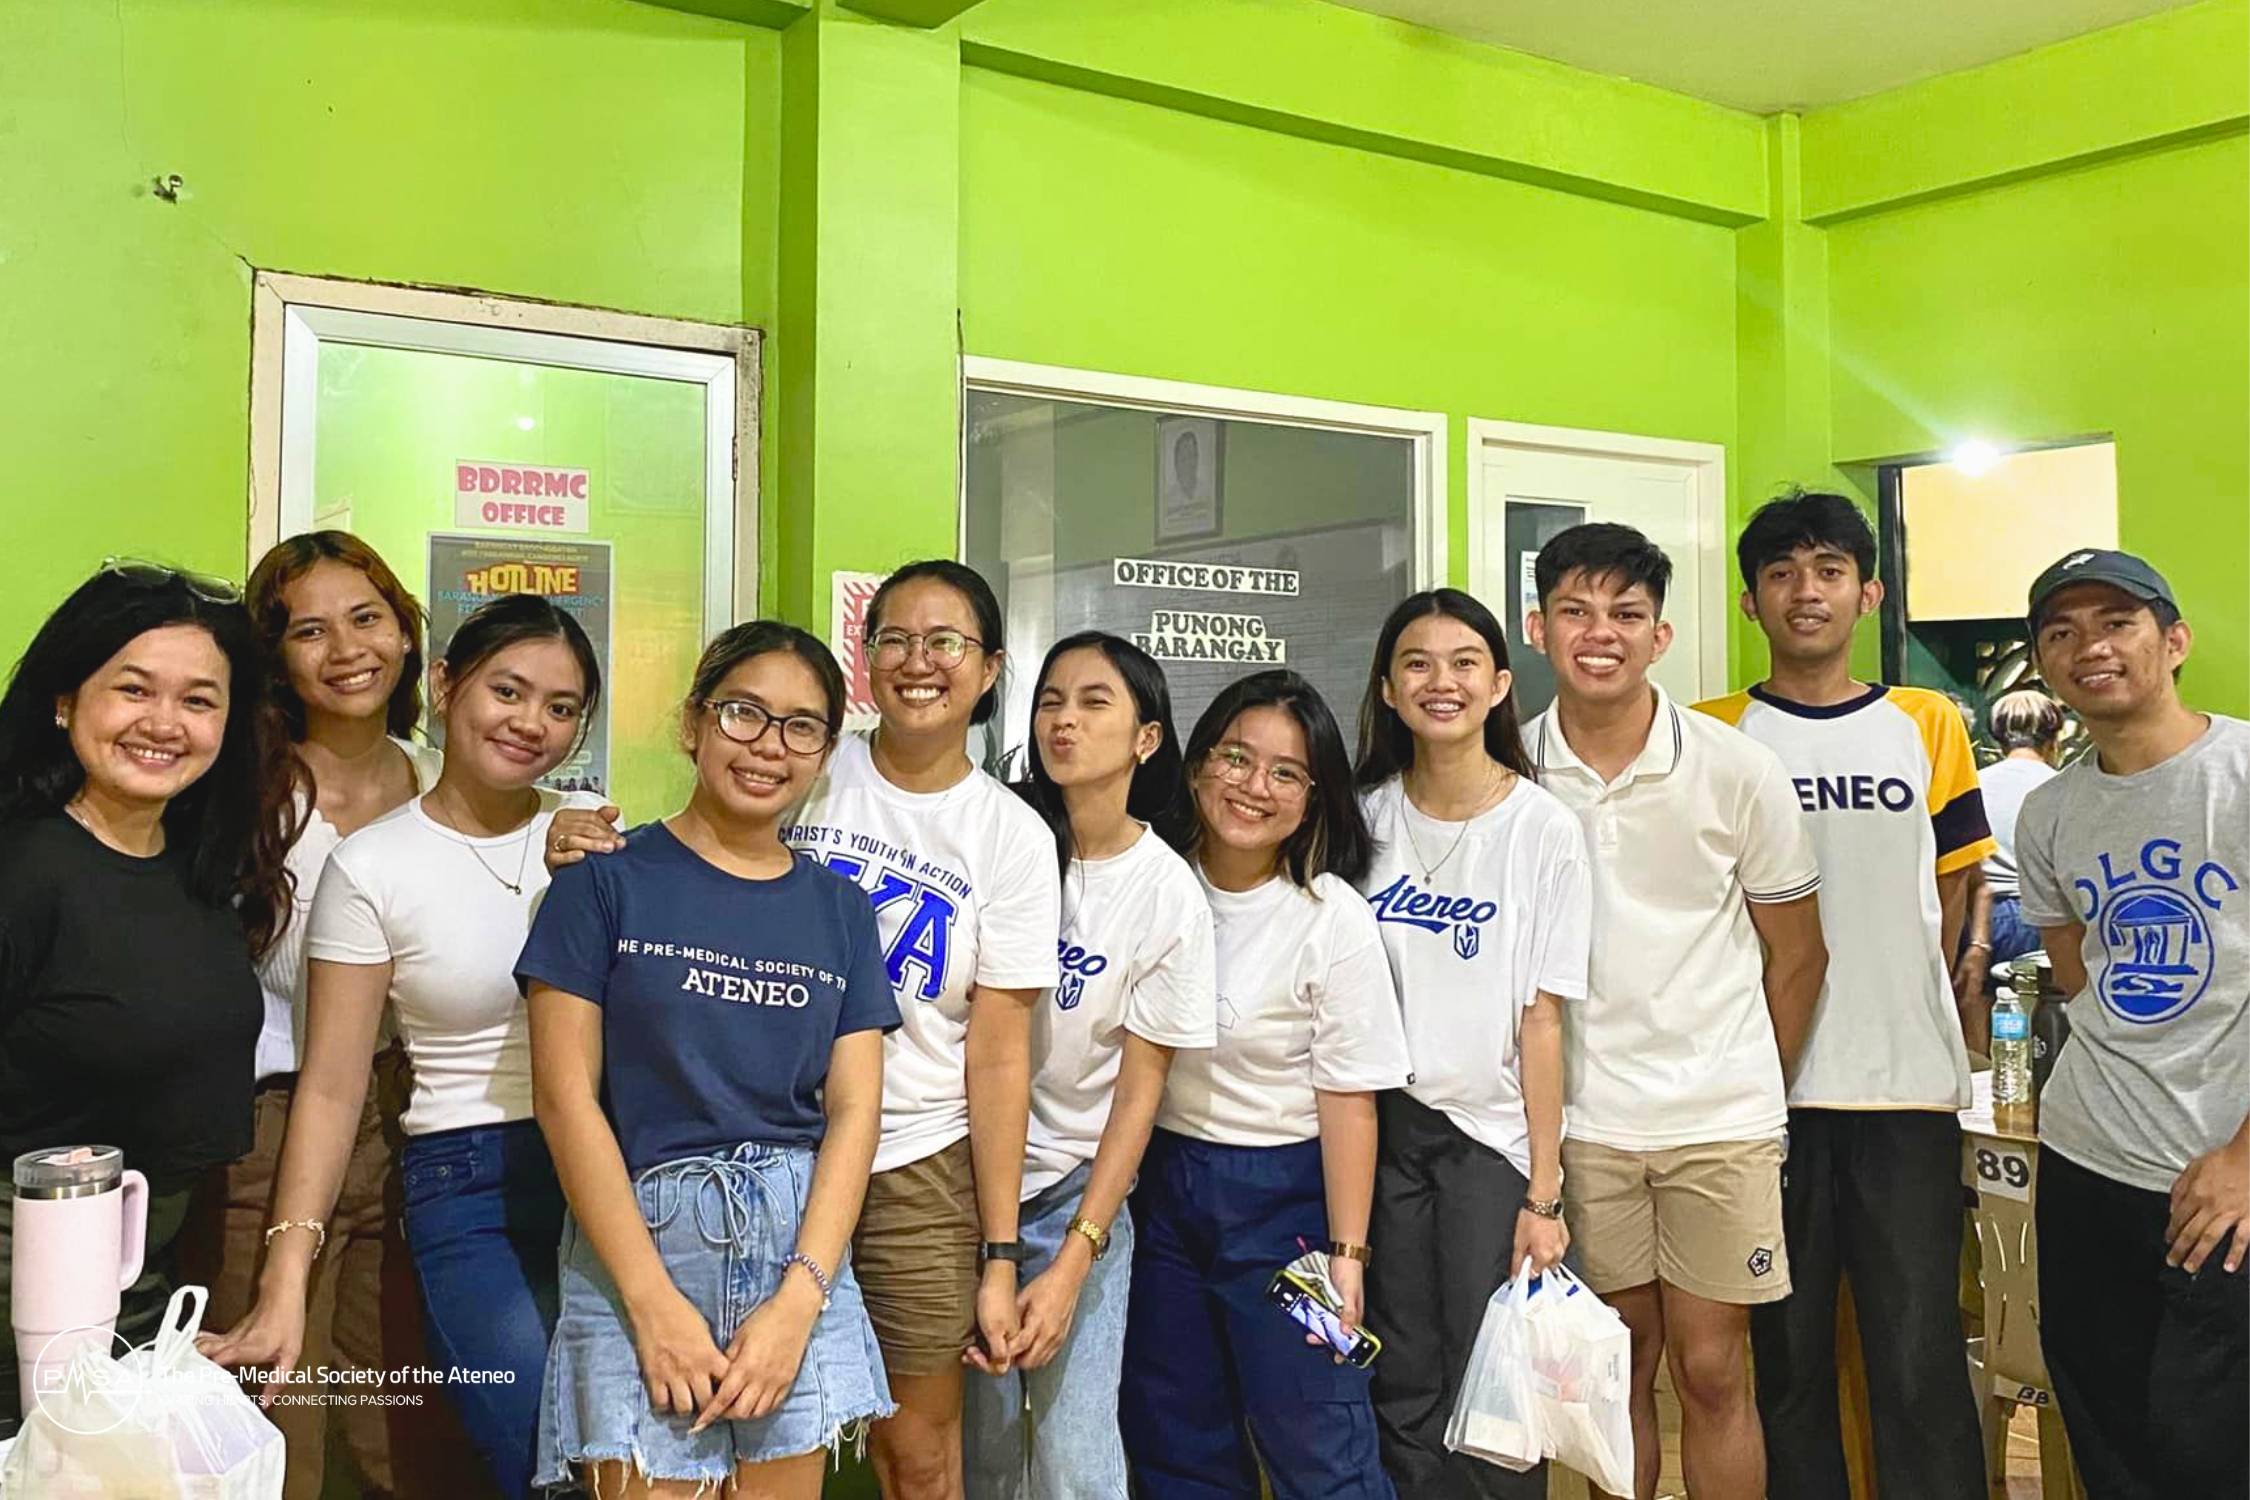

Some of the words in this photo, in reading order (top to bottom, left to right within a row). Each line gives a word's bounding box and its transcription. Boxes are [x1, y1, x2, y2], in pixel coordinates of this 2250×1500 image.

[457, 465, 587, 498] BDRRMC
[482, 502, 565, 525] OFFICE
[466, 563, 579, 595] HOTLINE
[1117, 562, 1209, 587] OFFICE
[1212, 569, 1244, 589] OF
[1248, 570, 1297, 592] THE
[549, 595, 605, 607] MERGENCY
[1155, 612, 1263, 638] PUNONG
[1135, 634, 1282, 661] BARANGAY
[778, 825, 843, 845] CHRIST'S
[850, 833, 899, 862] YOUTH
[918, 862, 972, 899] ACTION
[1367, 874, 1497, 934] Ateneo
[643, 942, 749, 970] PRE-MEDICAL
[755, 960, 815, 978] SOCIETY
[819, 970, 834, 984] OF
[681, 967, 810, 1008] ATENEO
[1977, 1148, 2030, 1188] 89
